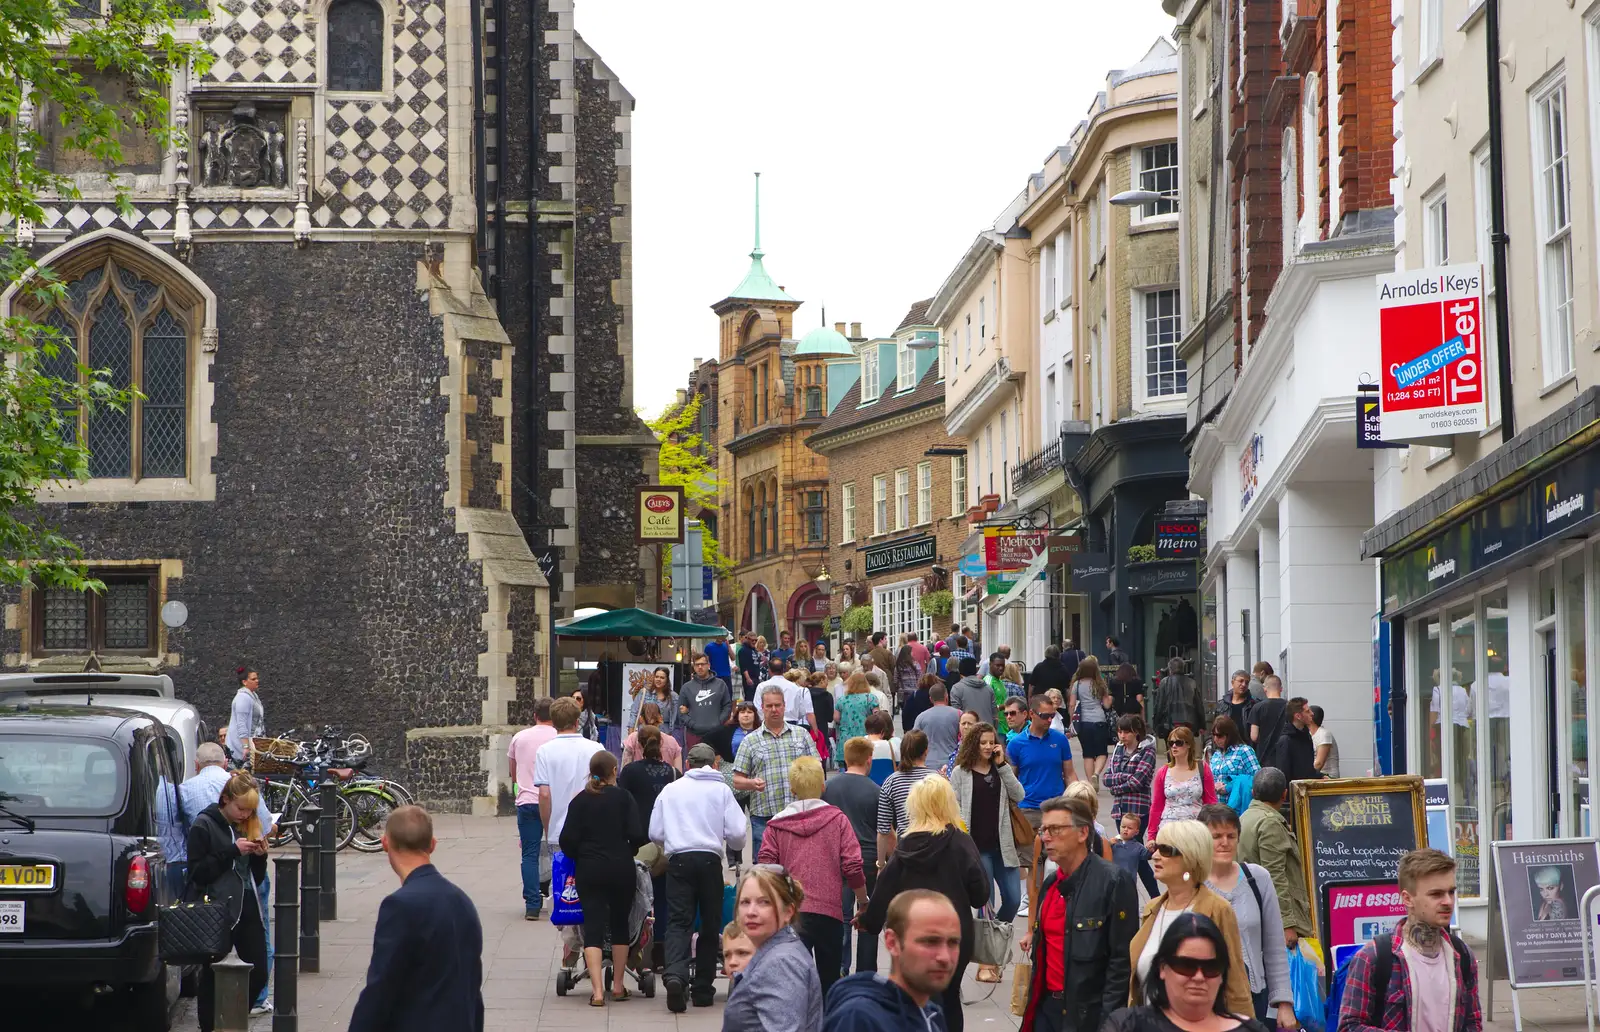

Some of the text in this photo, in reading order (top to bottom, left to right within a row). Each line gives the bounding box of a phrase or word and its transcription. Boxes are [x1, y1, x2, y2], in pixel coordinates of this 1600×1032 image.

[1380, 275, 1479, 300] Arnolds Keys
[1450, 300, 1477, 402] To Let
[1397, 358, 1431, 384] UNDER
[1431, 341, 1465, 366] OFFER
[1387, 387, 1441, 402] (1,284 SQ FT)
[1418, 408, 1477, 419] arnoldskeys.com
[1430, 417, 1478, 429] 01603 620551
[647, 515, 671, 525] Café
[1158, 524, 1197, 533] TESCO
[1000, 535, 1041, 547] Method
[1158, 538, 1197, 549] Metro
[866, 542, 933, 569] PAOLO'S RESTAURANT
[1345, 799, 1390, 815] WINE
[1365, 795, 1384, 804] THE
[1330, 811, 1393, 827] CELLAR
[1352, 845, 1386, 858] topped
[1512, 850, 1585, 865] Hairsmiths
[12, 868, 46, 884] VOD
[1333, 892, 1363, 910] just
